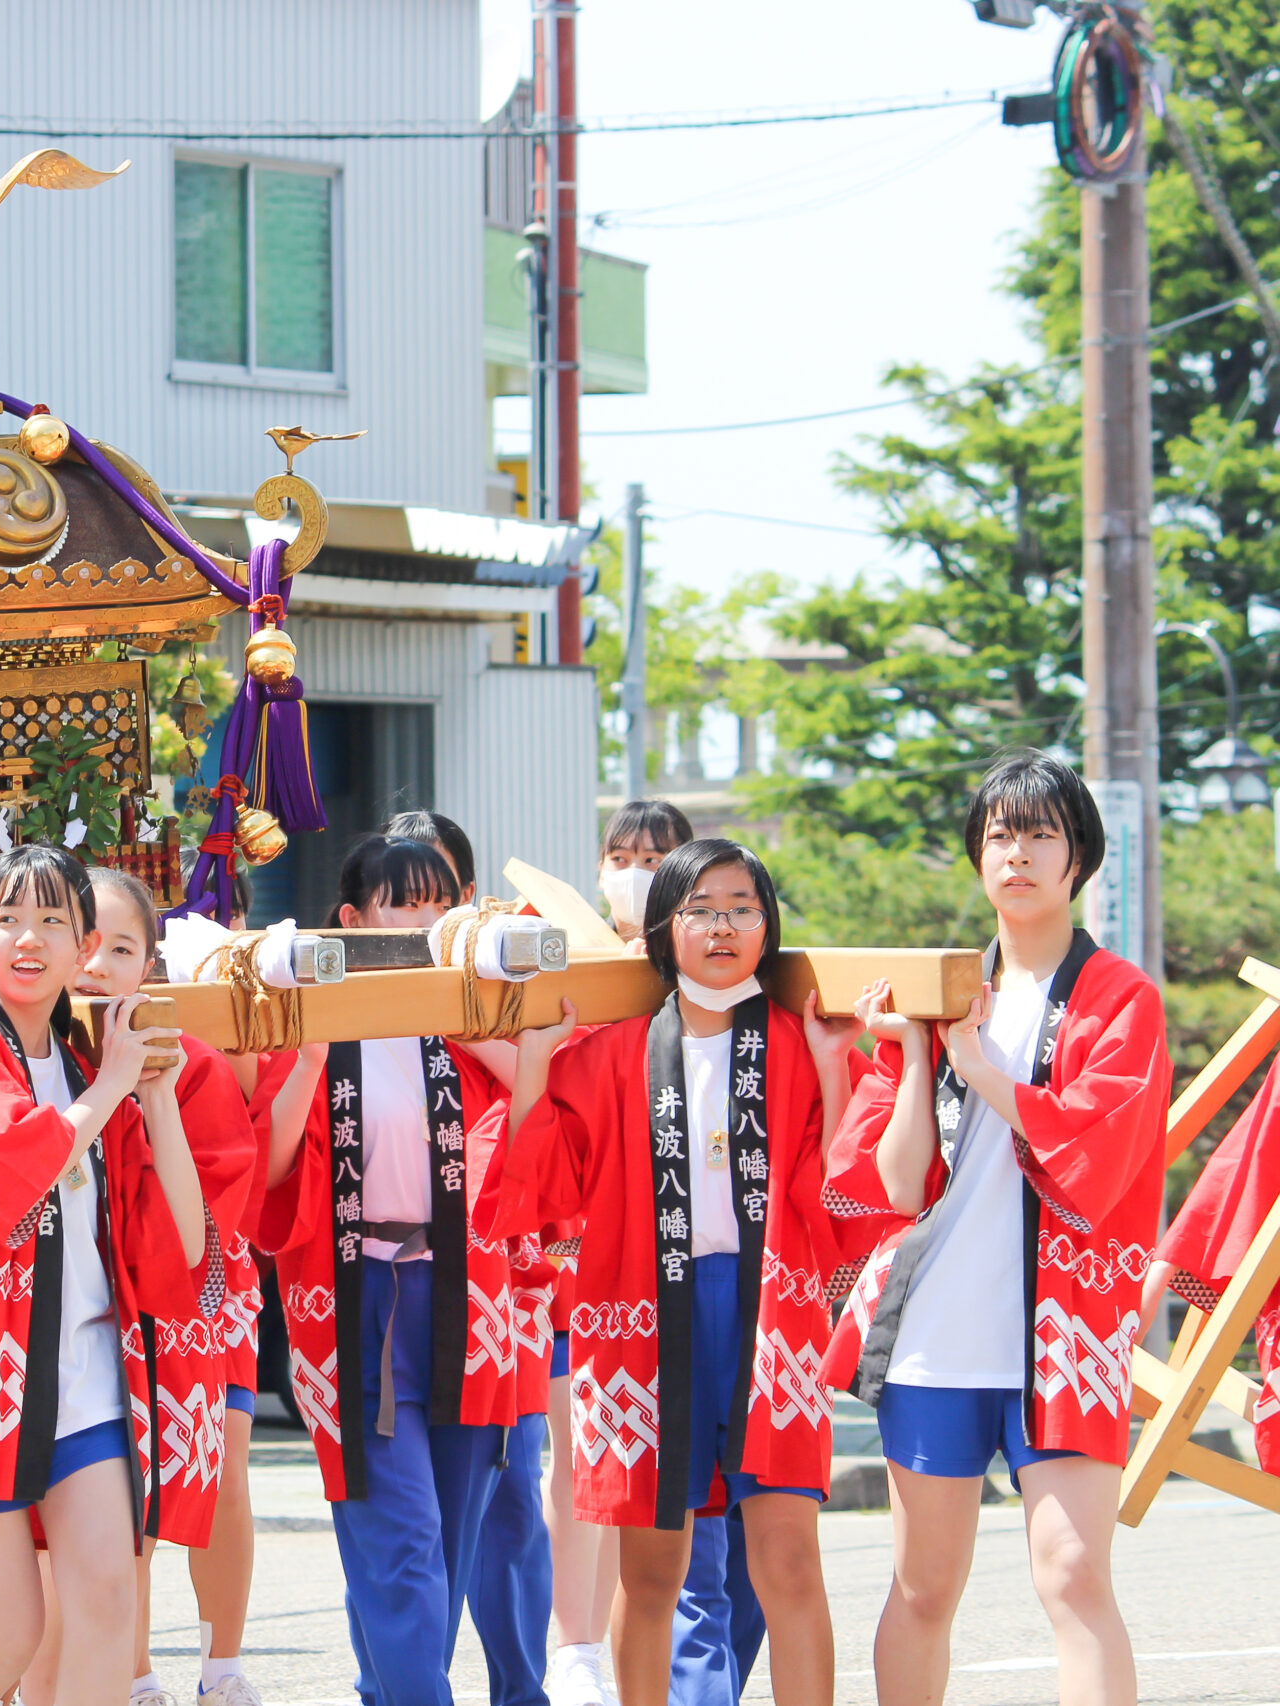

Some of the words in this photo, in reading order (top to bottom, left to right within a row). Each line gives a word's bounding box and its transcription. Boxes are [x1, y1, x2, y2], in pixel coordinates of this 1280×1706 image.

[331, 1078, 363, 1263] 井波八幡宮
[654, 1085, 690, 1282] 井波八幡宮
[734, 1028, 769, 1223] 井波八幡宮
